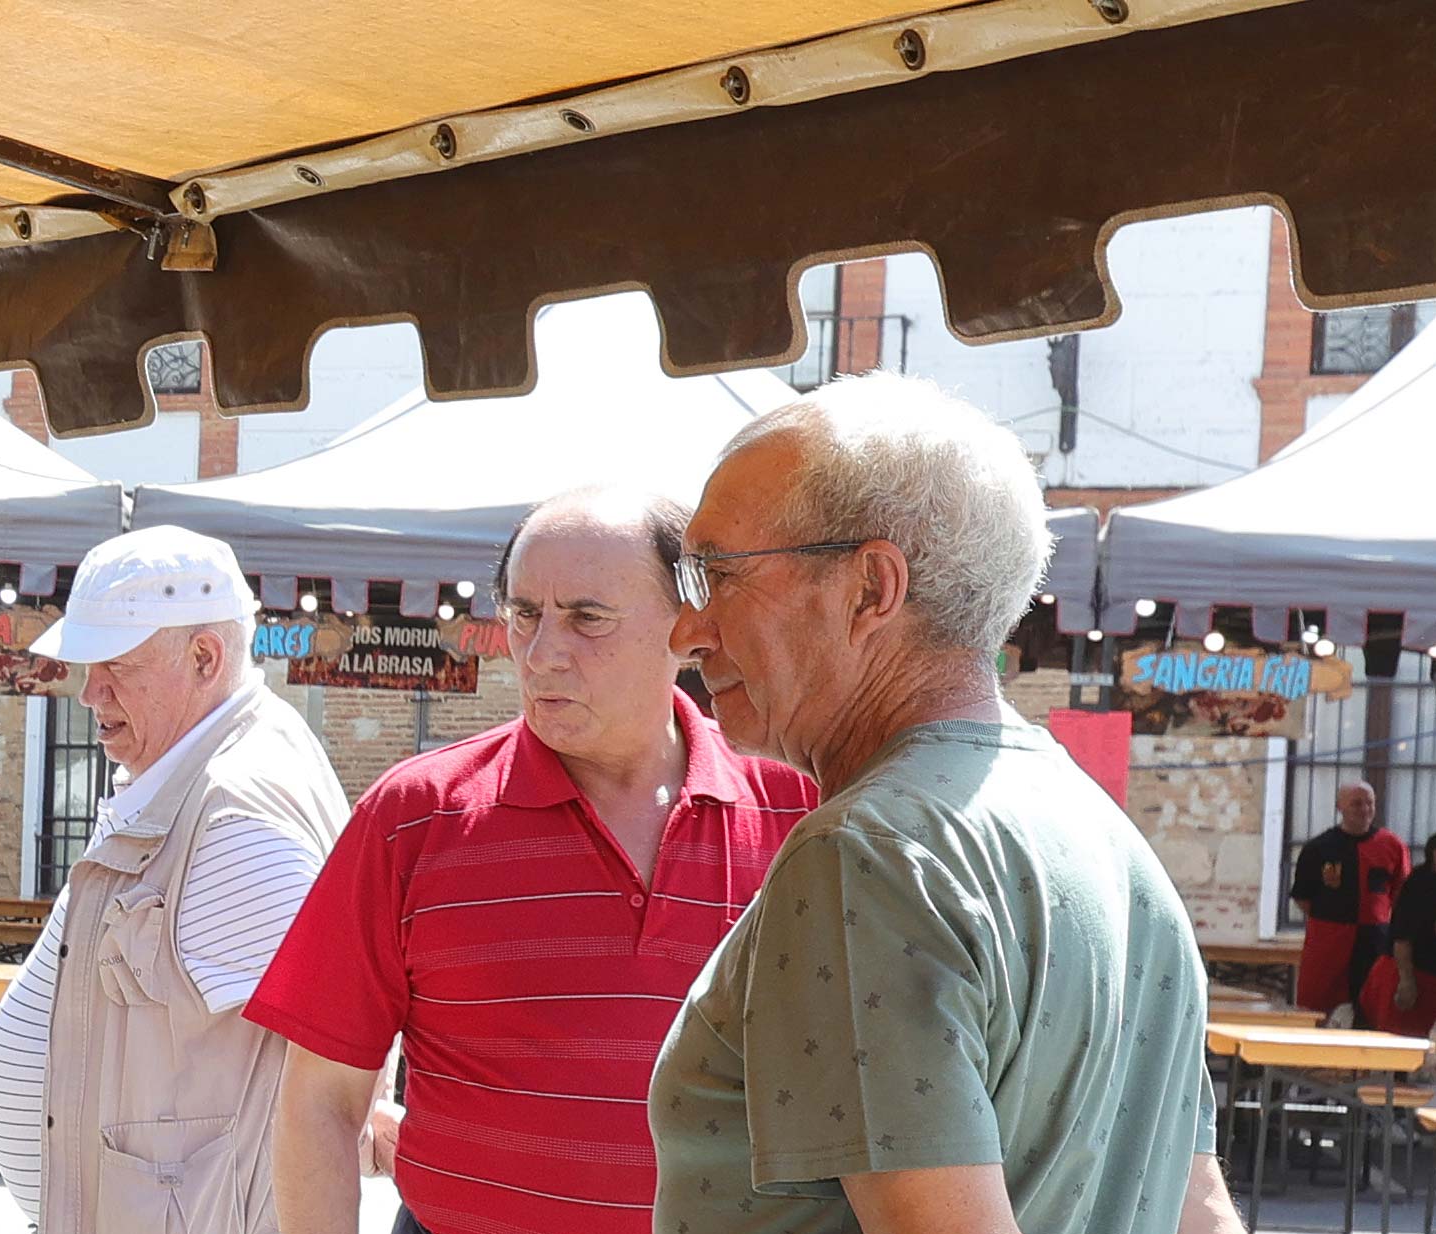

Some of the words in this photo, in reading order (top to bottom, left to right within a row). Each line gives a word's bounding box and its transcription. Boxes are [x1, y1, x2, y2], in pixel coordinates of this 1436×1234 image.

[338, 653, 351, 673] A
[352, 654, 375, 674] LA
[377, 655, 434, 677] BRASA
[1133, 652, 1254, 694] SANGRIA
[1259, 655, 1311, 700] FRIA
